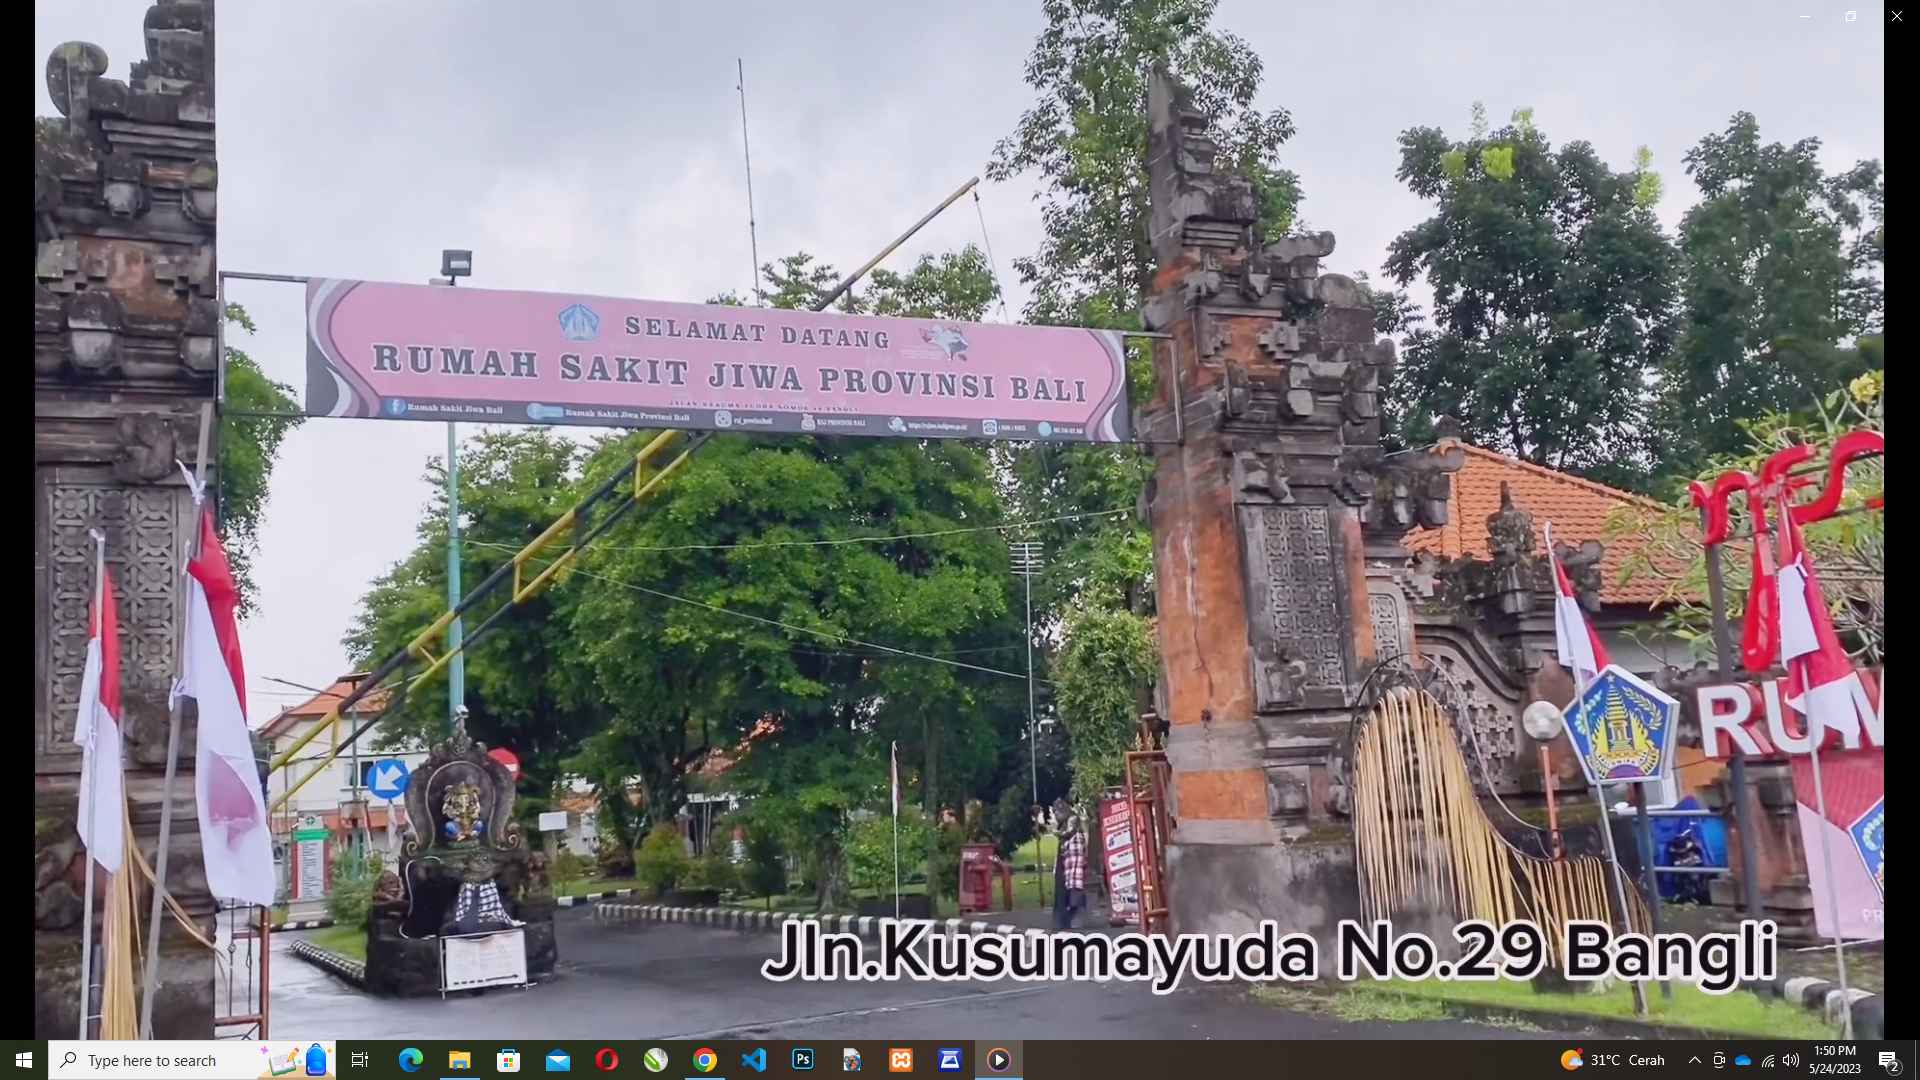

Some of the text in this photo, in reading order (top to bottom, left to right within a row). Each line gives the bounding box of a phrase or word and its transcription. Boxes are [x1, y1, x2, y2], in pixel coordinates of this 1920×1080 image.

[625, 316, 889, 349] SELAMAT DATANG
[372, 344, 1086, 402] RUMAH SAKIT JIWA PROVINSI BALI
[407, 403, 438, 412] Rumah
[440, 404, 463, 412] Sakit
[486, 406, 503, 414] Bali
[565, 409, 690, 421] Rumah Sakit Jiwa Provinsi Bali
